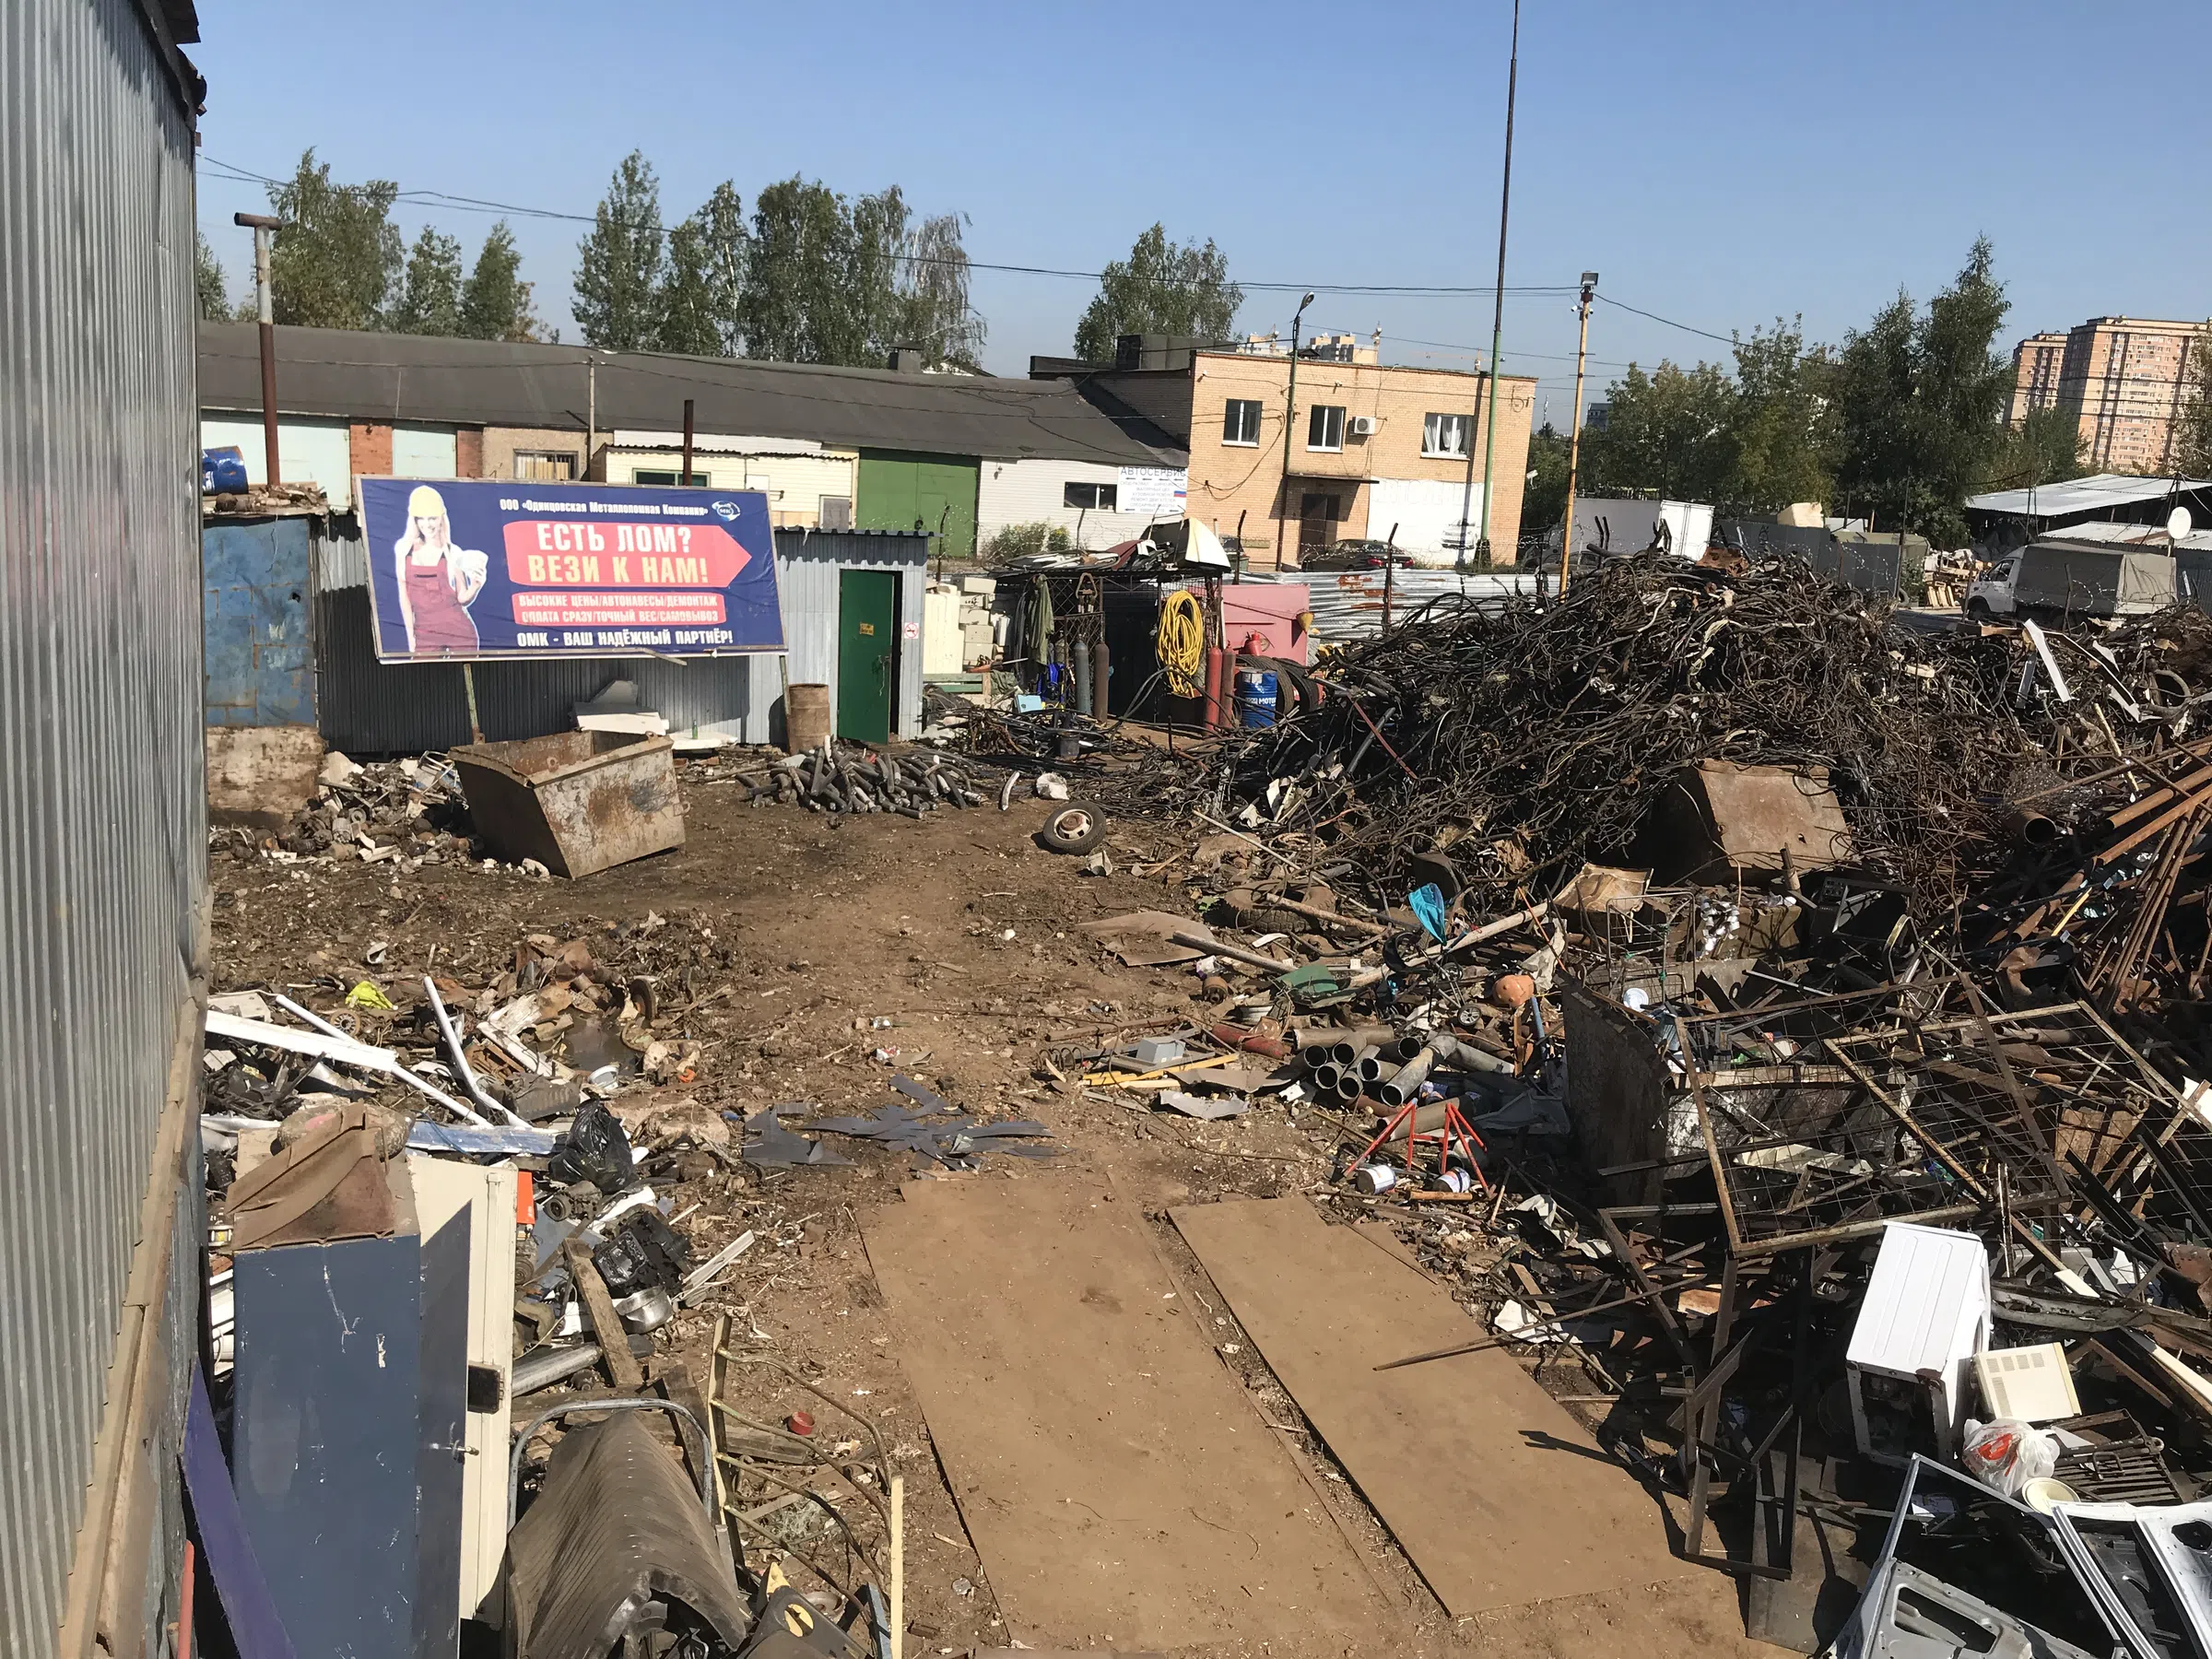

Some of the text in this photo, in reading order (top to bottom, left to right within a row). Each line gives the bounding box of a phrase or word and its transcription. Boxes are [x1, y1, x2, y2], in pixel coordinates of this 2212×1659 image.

[1120, 467, 1186, 477] АВТОСЕРВИС
[500, 499, 519, 511] ООО
[536, 523, 691, 553] ЕСТЬ ЛОМ?
[528, 555, 709, 583] ВЕЗИ К НАМ!
[519, 594, 568, 606] ВЫСОКИЕ
[522, 611, 559, 623] ОПЛАТА
[517, 632, 549, 647] ОМК
[563, 631, 594, 646] ВАШ
[597, 629, 672, 647] НАДЁЖНЫЙ
[675, 628, 734, 644] ПАРТНЁР!
